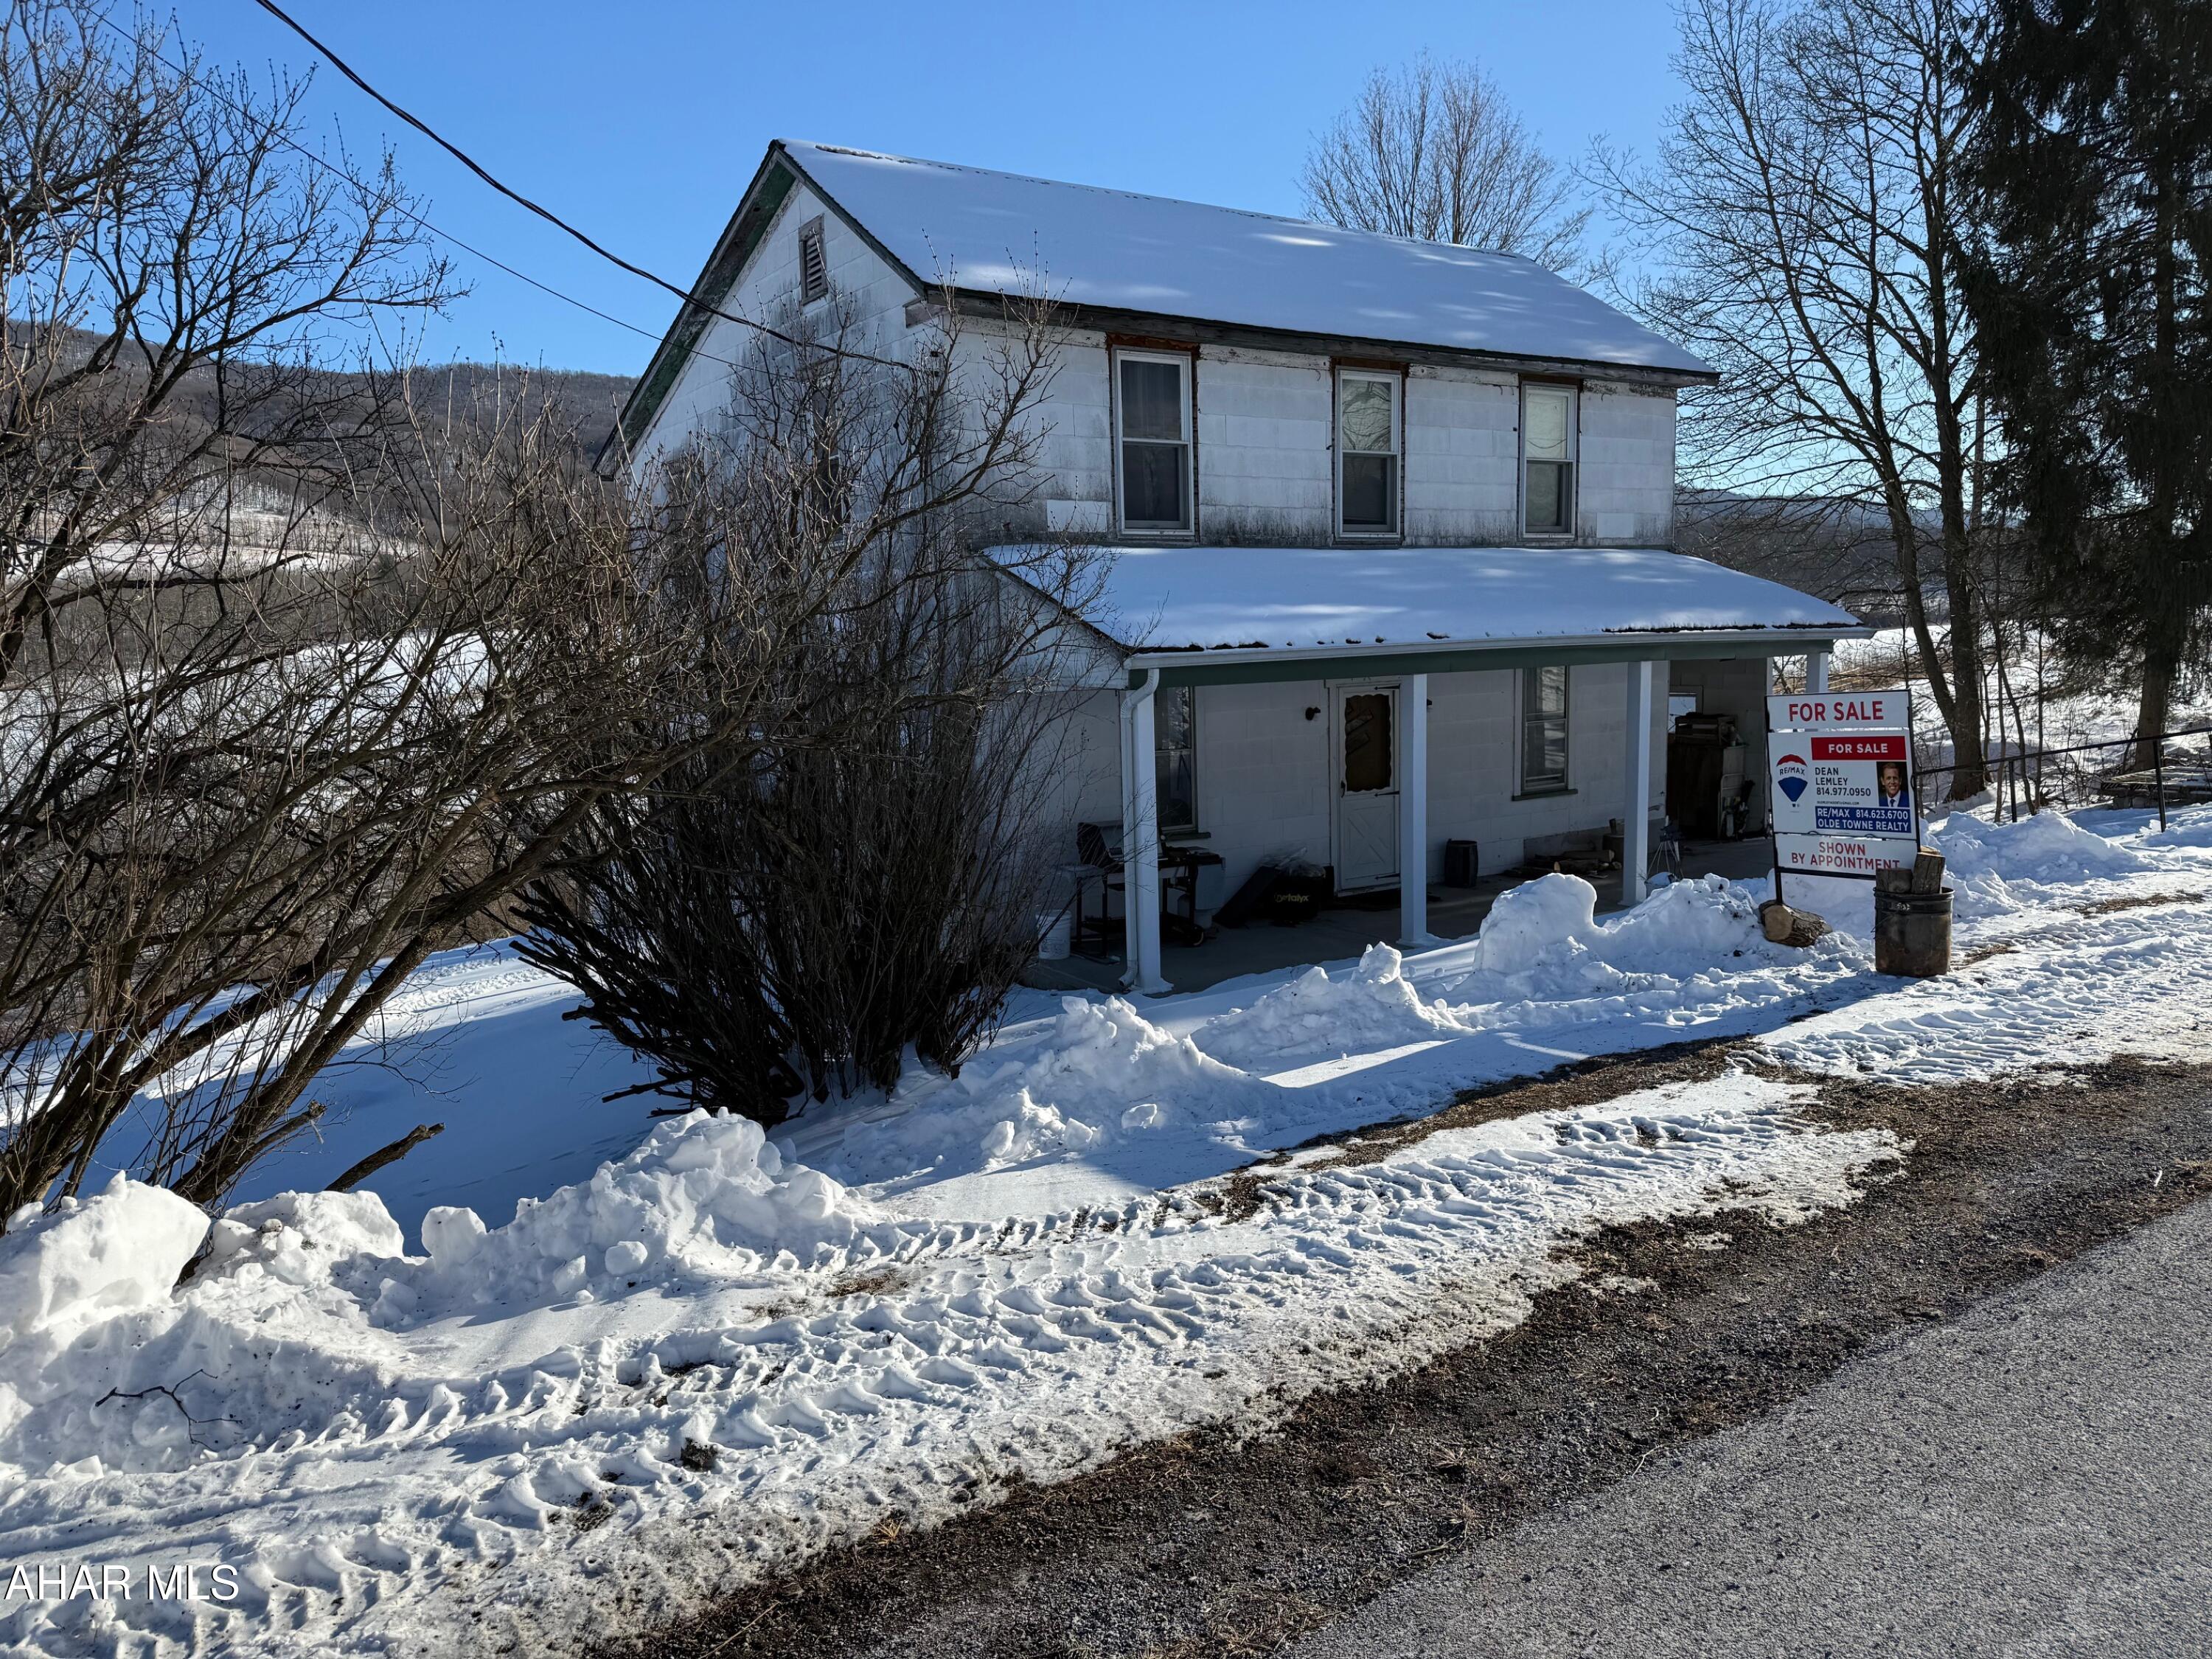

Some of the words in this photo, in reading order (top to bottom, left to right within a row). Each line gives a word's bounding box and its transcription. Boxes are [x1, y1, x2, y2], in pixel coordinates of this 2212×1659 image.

[1789, 703, 1826, 722] FOR
[1833, 700, 1884, 721] SALE
[1828, 743, 1853, 754] FOR
[1857, 742, 1888, 754] SALE
[1779, 767, 1805, 776] RE/MAX
[1815, 767, 1839, 776] DEAN
[1815, 777, 1848, 786] LEMLEY
[1816, 787, 1871, 796] 814.977.0950
[1817, 807, 1850, 818] RE/MAX
[1856, 810, 1908, 820] 814.623.6700
[1818, 818, 1840, 828] OLDE
[1842, 820, 1874, 830] TOWNE
[1876, 821, 1908, 831] REALTY
[1819, 841, 1866, 856] SHOWN
[1791, 852, 1806, 864] BY
[1810, 854, 1900, 870] APPOINTMENT
